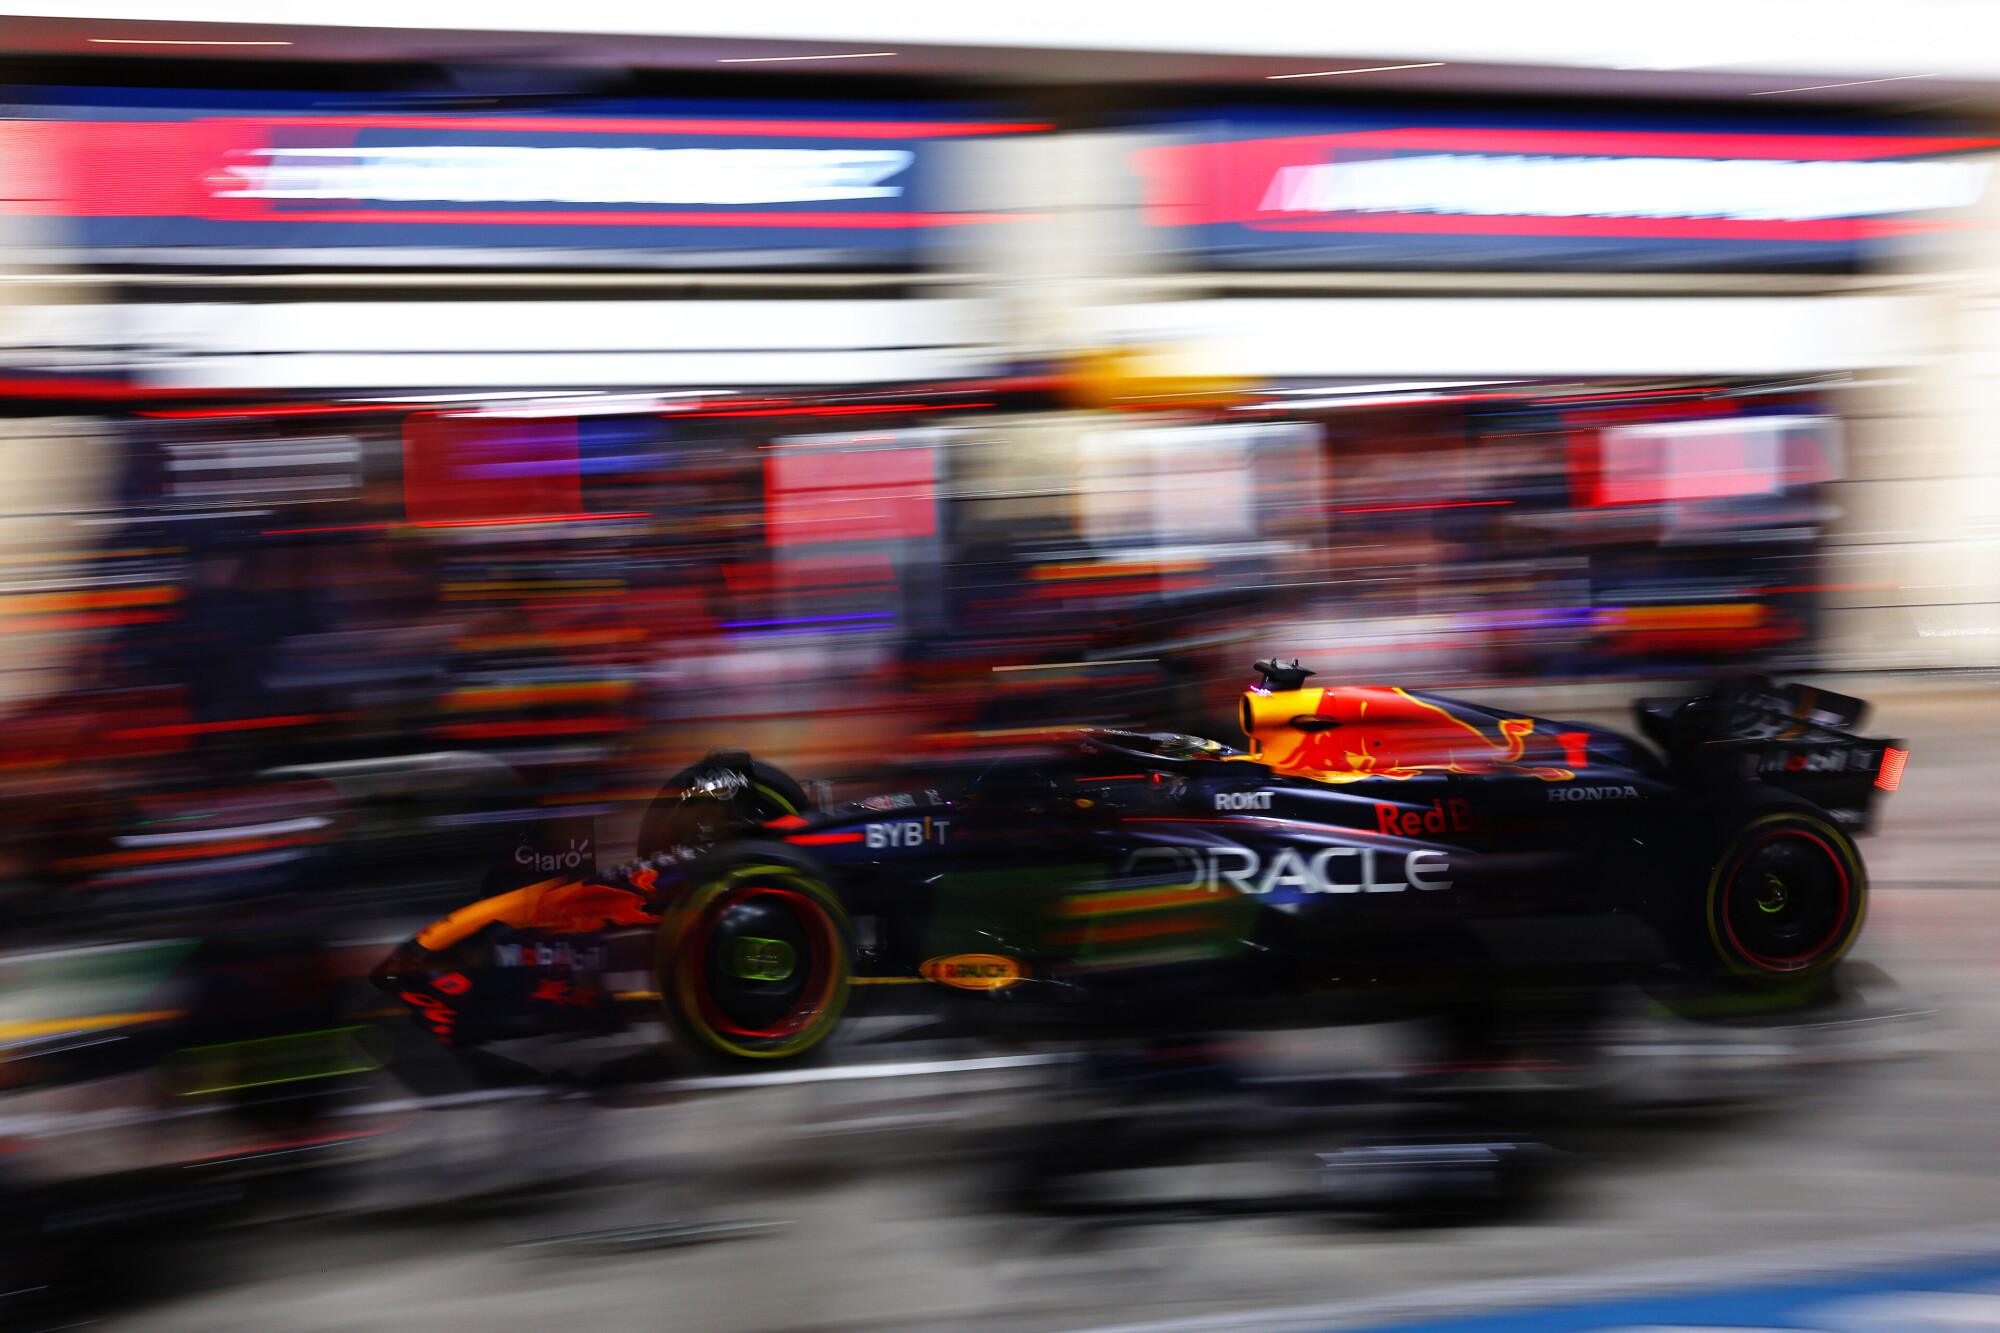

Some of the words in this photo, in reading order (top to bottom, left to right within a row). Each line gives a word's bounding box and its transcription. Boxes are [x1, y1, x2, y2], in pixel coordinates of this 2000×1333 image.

[1215, 791, 1275, 811] ROKT
[1546, 786, 1640, 802] HONDA
[1374, 798, 1447, 835] Red
[866, 816, 951, 849] BYBIT
[515, 843, 582, 871] Claro
[1122, 846, 1455, 895] ORACLE
